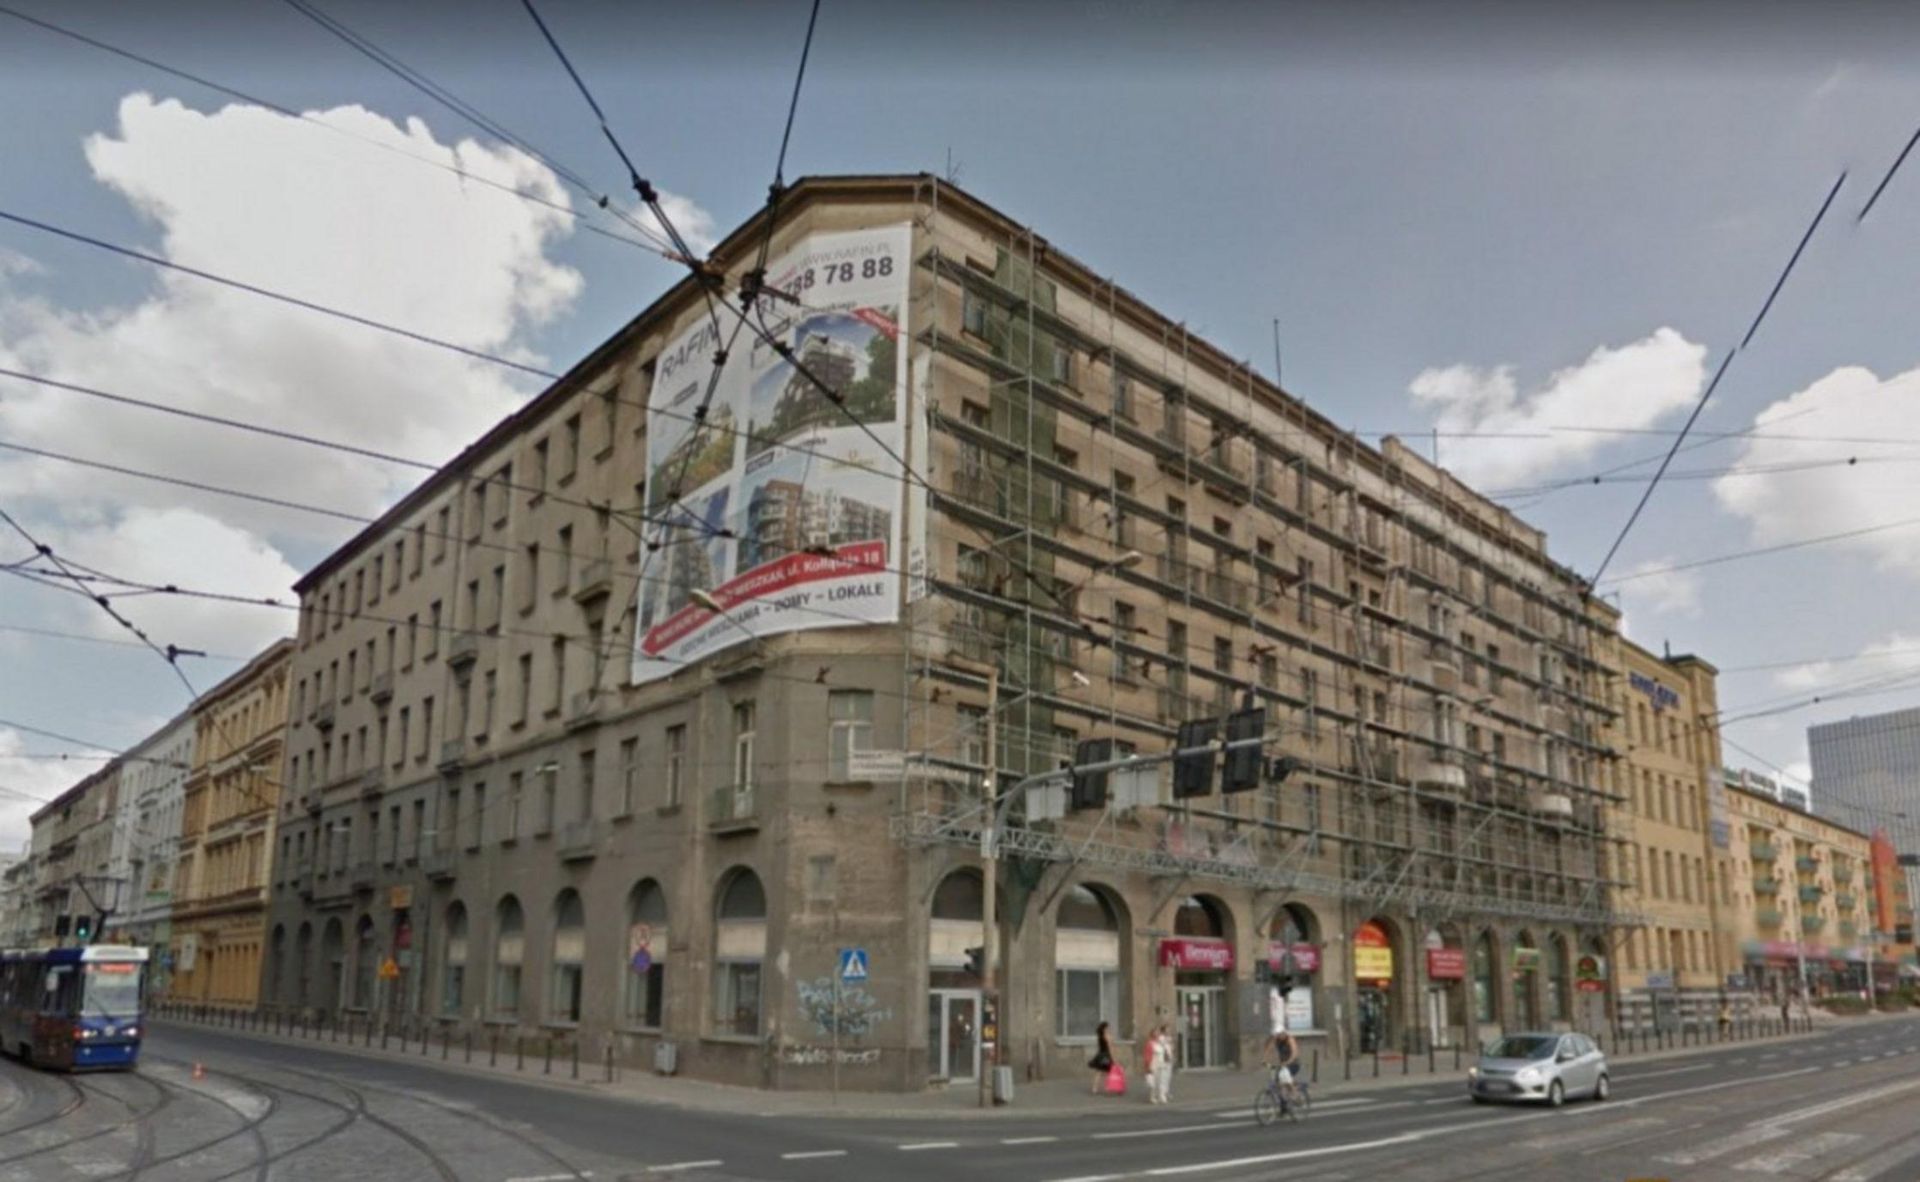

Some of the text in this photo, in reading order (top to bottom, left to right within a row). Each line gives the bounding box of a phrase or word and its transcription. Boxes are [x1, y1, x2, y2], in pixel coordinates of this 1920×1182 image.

[824, 262, 854, 285] 78
[862, 256, 893, 278] 88
[659, 318, 719, 385] RAFIN
[863, 551, 880, 564] 18
[828, 582, 885, 601] LOKALE
